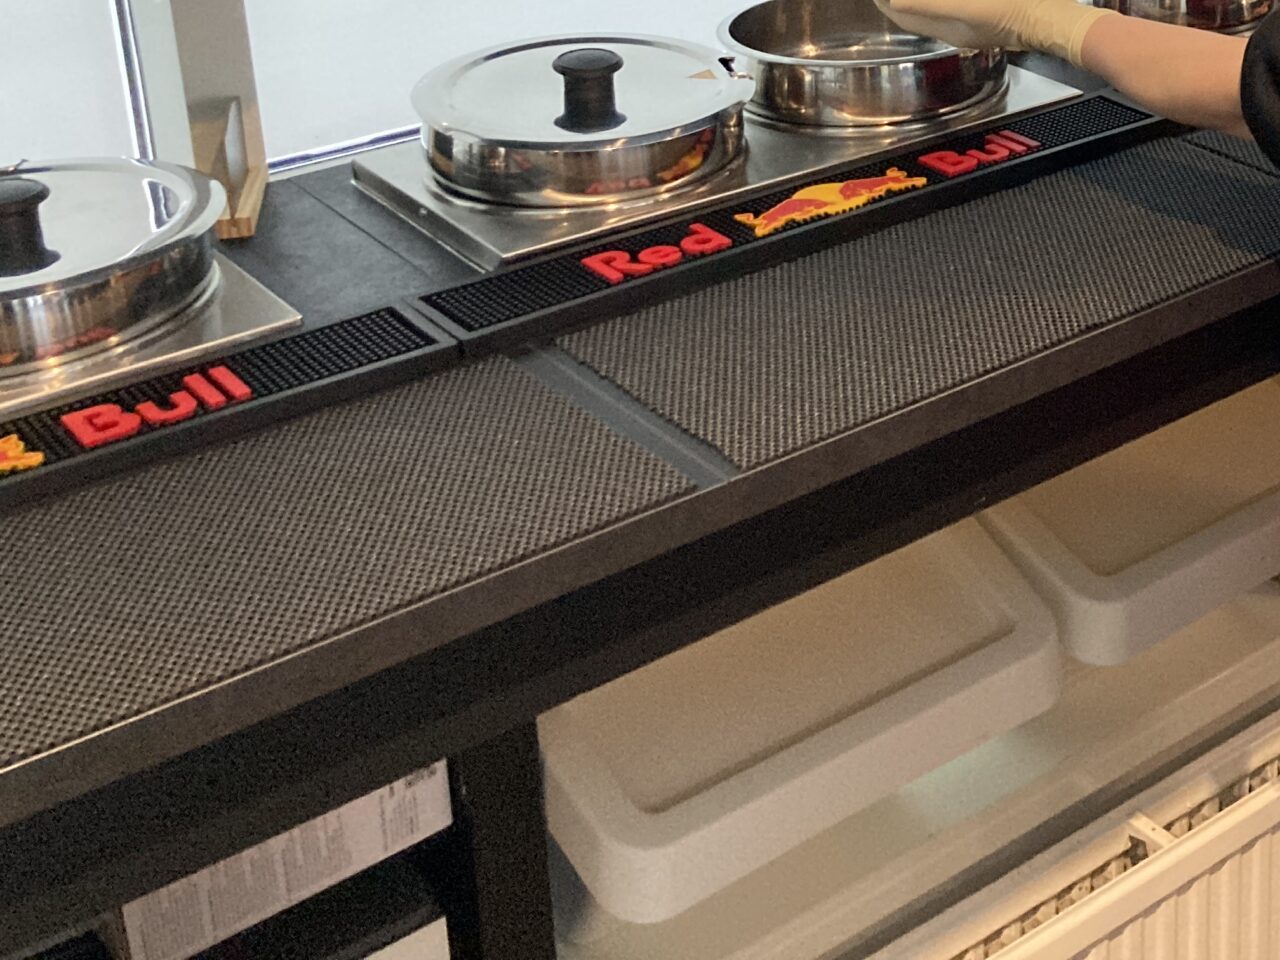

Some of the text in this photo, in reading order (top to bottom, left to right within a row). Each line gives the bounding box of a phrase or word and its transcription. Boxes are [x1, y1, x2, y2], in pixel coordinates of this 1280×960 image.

[580, 130, 1042, 284] Red Bull
[61, 365, 253, 448] Bull
